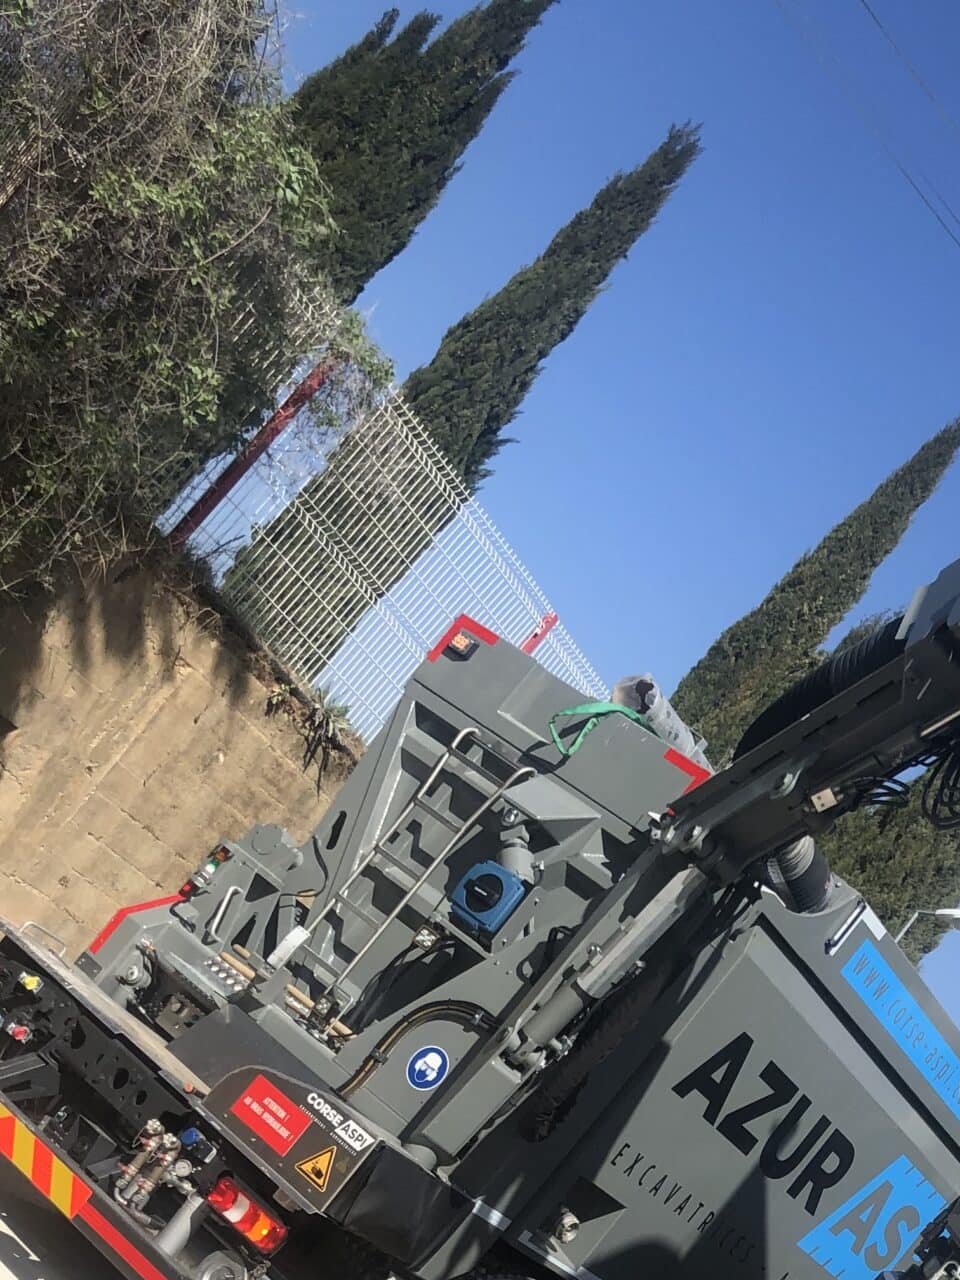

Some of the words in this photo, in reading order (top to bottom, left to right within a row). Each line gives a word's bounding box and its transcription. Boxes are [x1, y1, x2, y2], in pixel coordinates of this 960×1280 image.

[306, 1092, 343, 1127] CORSE
[340, 1121, 369, 1148] ASPI
[671, 1031, 855, 1215] AZUR
[829, 1180, 921, 1272] AS
